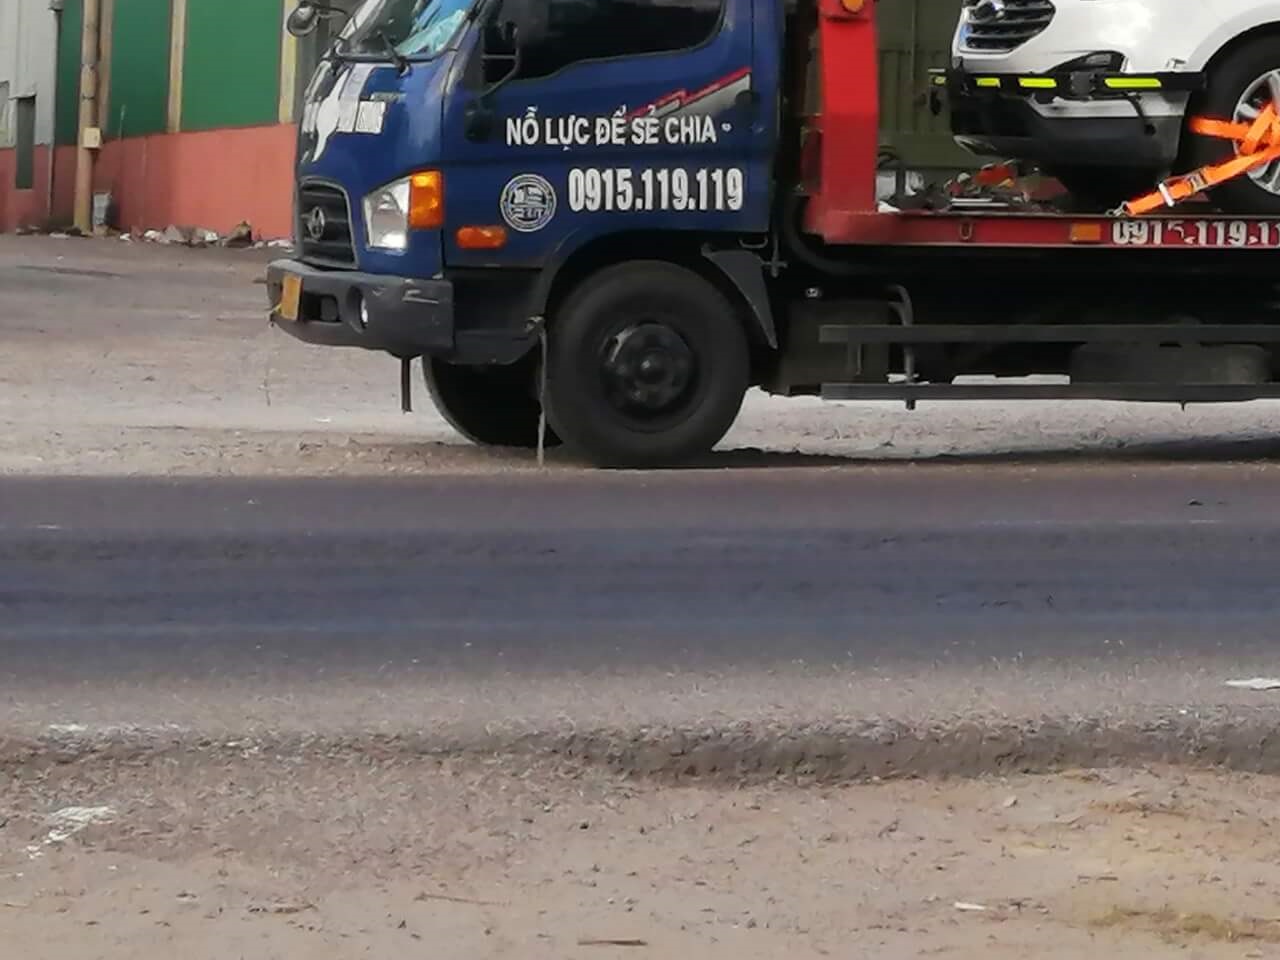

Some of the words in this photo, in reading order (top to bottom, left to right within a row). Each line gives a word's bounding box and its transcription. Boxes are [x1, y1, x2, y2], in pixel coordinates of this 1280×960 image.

[505, 106, 540, 146] NỖ
[545, 115, 591, 152] LỰC
[595, 104, 627, 146] ĐỂ
[664, 115, 717, 144] CHIA
[568, 167, 743, 212] 0915.119.119
